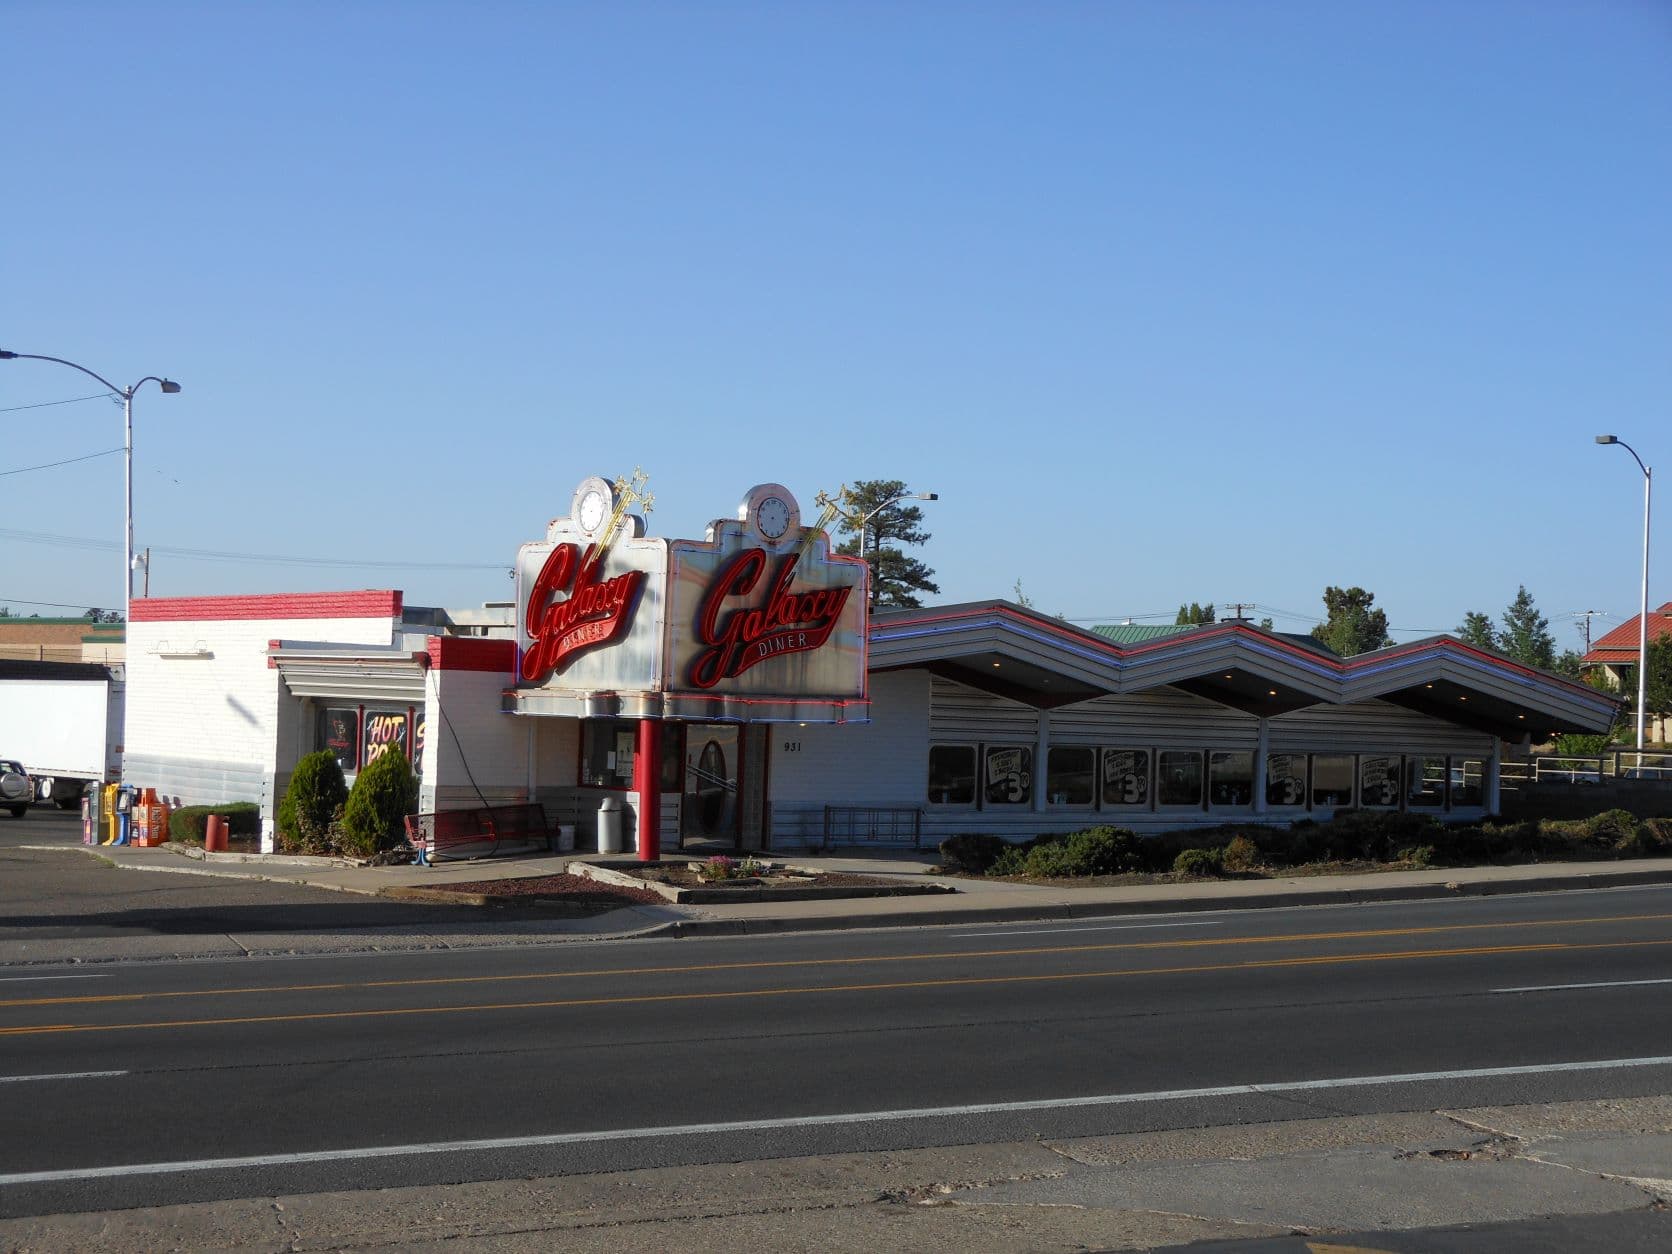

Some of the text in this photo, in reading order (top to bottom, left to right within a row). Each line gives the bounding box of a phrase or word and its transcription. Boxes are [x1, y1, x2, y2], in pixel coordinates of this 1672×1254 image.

[521, 542, 643, 680] Galaxy
[692, 548, 852, 688] Galaxy
[563, 622, 602, 650] DINER
[758, 633, 807, 656] DINER
[371, 716, 404, 742] HOT
[784, 742, 801, 752] 931
